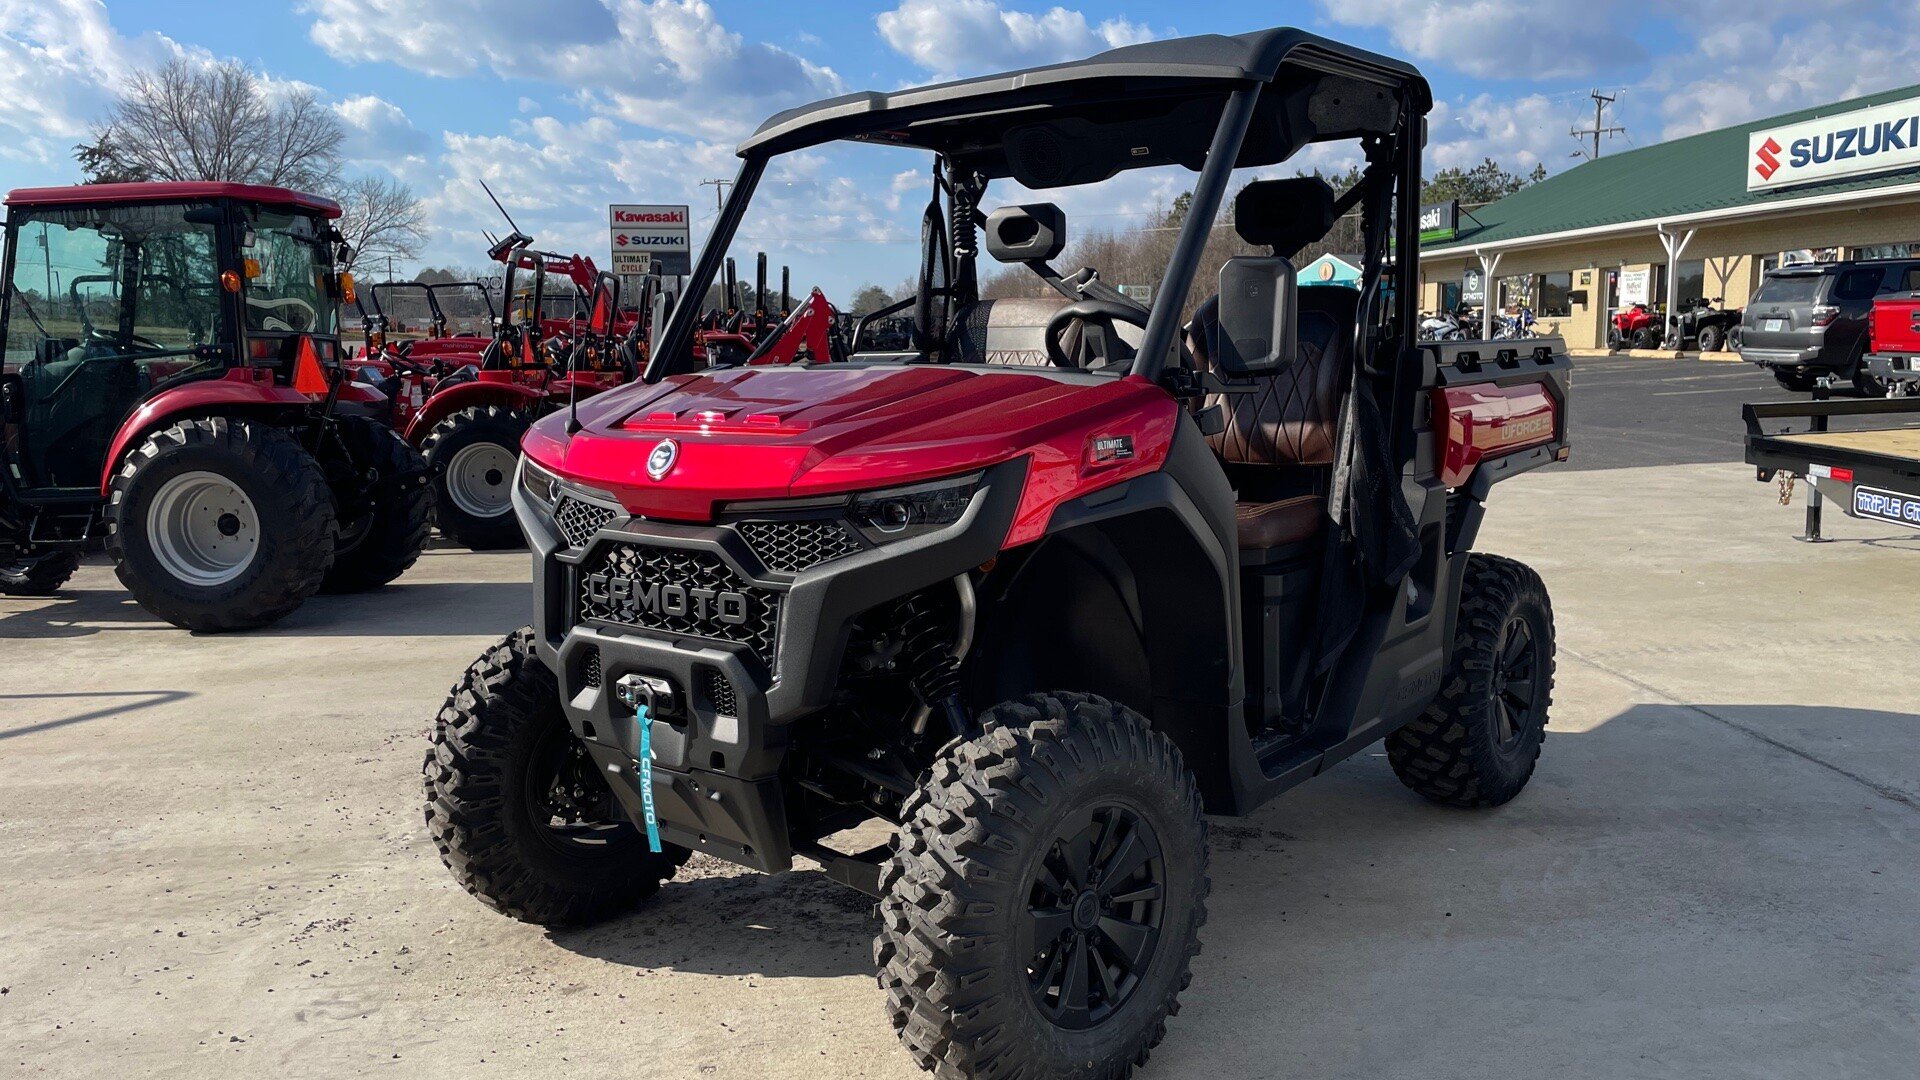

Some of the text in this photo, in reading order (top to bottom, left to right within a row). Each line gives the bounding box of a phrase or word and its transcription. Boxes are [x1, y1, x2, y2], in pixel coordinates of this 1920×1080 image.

[1789, 115, 1920, 168] SUZUKI
[614, 210, 684, 223] Kawasaki
[1420, 208, 1440, 229] saki
[631, 236, 685, 245] SUZUKI
[614, 255, 649, 264] ULTIMATE
[621, 264, 644, 273] CYCLE
[1097, 438, 1123, 451] ULTIMATE
[589, 573, 747, 625] CFMOTO
[642, 757, 656, 825] CFMOTO
